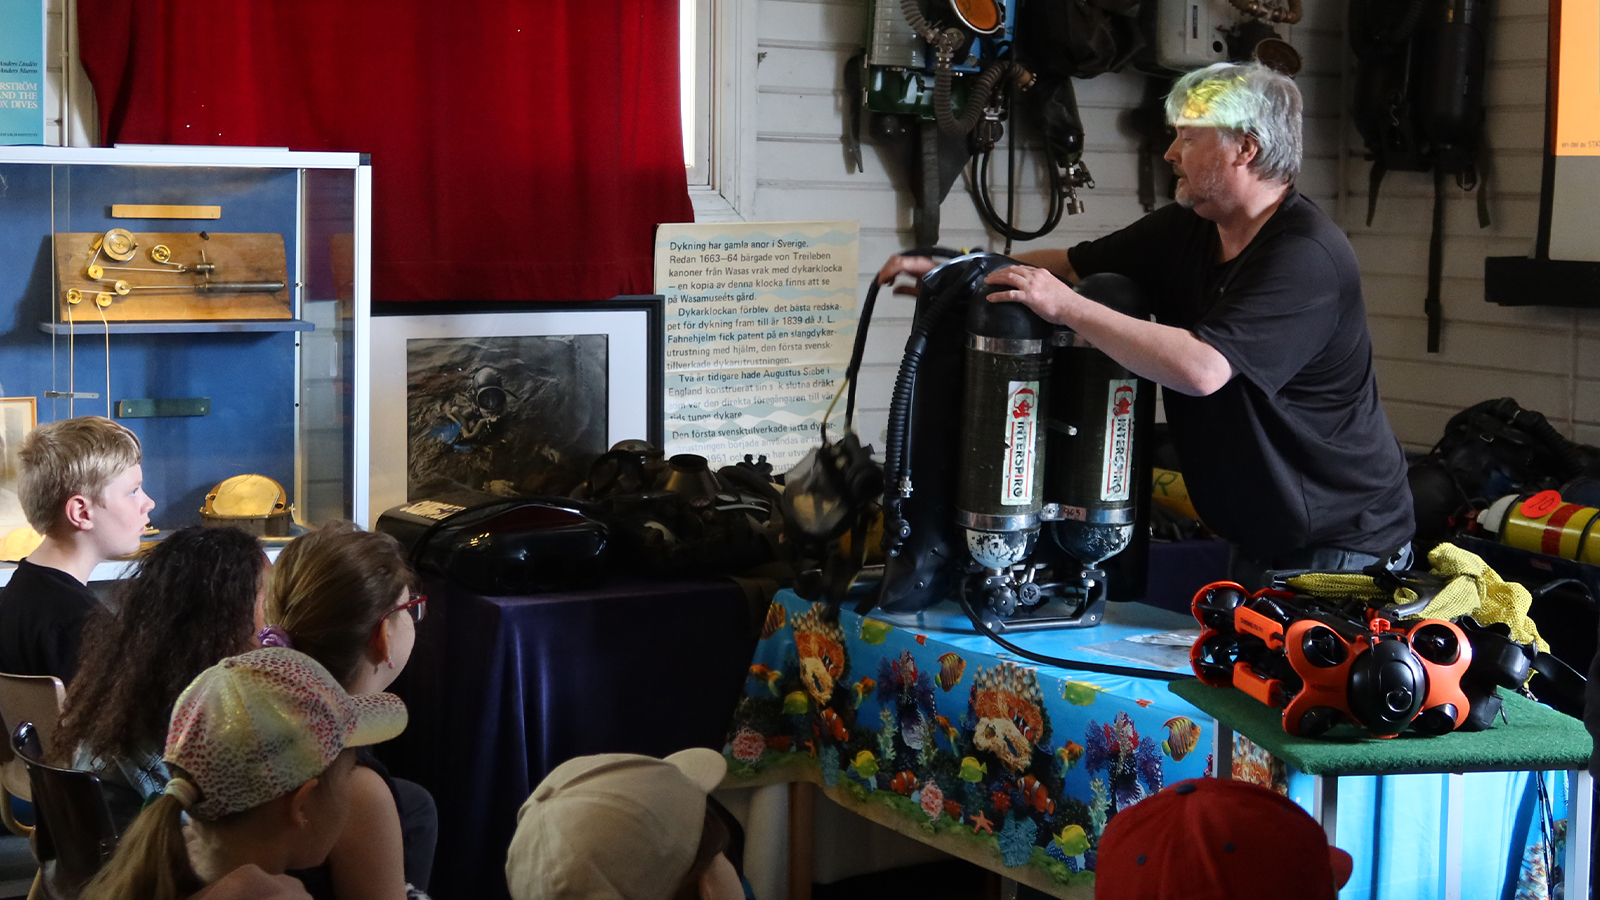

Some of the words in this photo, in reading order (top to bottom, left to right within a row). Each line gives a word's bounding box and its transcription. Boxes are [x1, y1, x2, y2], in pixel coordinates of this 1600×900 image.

[11, 100, 38, 109] DIVES
[670, 241, 706, 251] Dykning
[708, 241, 722, 250] har
[724, 240, 749, 250] gamla
[751, 241, 769, 249] anor
[772, 240, 775, 248] i
[777, 239, 809, 249] Sverige.
[670, 255, 696, 264] Redan
[740, 253, 773, 263] bärgade
[669, 269, 703, 277] kanoner
[705, 267, 722, 275] från
[725, 267, 749, 275] Wasas
[751, 266, 769, 274] vrak
[772, 265, 789, 274] med
[792, 264, 843, 274] dykarklocka
[690, 281, 715, 290] kopia
[728, 280, 753, 288] denna
[756, 279, 783, 287] klocka
[785, 278, 806, 286] finns
[808, 278, 820, 286] att
[668, 295, 678, 304] på
[736, 292, 757, 302] gård.
[678, 306, 738, 317] Dykarklockan
[739, 306, 769, 314] förblev
[774, 304, 787, 312] det
[790, 304, 811, 312] bästa
[667, 322, 681, 331] pet
[683, 320, 697, 329] för
[698, 319, 733, 329] dykning
[735, 319, 755, 327] fram
[757, 318, 769, 326] till
[771, 317, 780, 325] år
[782, 316, 803, 325] 1839
[805, 316, 815, 324] då
[816, 315, 824, 324] J.
[827, 315, 835, 323] L.
[667, 334, 716, 344] Fahnehjelm
[719, 333, 735, 341] fick
[737, 332, 764, 342] patent
[767, 330, 777, 340] på
[779, 331, 788, 339] en
[791, 327, 836, 339] slangdykar-
[666, 344, 710, 357] utrustning
[712, 345, 730, 355] med
[733, 344, 759, 355] hjälm,
[761, 343, 776, 352] den
[779, 342, 803, 351] första
[804, 341, 833, 350] svensk-
[667, 360, 711, 370] tillverkade
[713, 356, 792, 369] dykarutrustningen.
[679, 373, 694, 382] Två
[696, 373, 705, 382] år
[708, 371, 739, 381] tidigare
[741, 369, 761, 379] hade
[763, 368, 801, 379] Augustus
[669, 387, 702, 398] England
[705, 384, 753, 394] konstruerat
[755, 383, 767, 391] sin
[785, 380, 811, 390] slutna
[813, 379, 834, 389] dräkt
[704, 398, 719, 408] den
[722, 396, 751, 407] direkta
[754, 394, 806, 405] föregångaren
[808, 392, 820, 401] till
[672, 431, 689, 440] Den
[692, 428, 716, 438] första
[1014, 421, 1024, 497] INTERSPIRO
